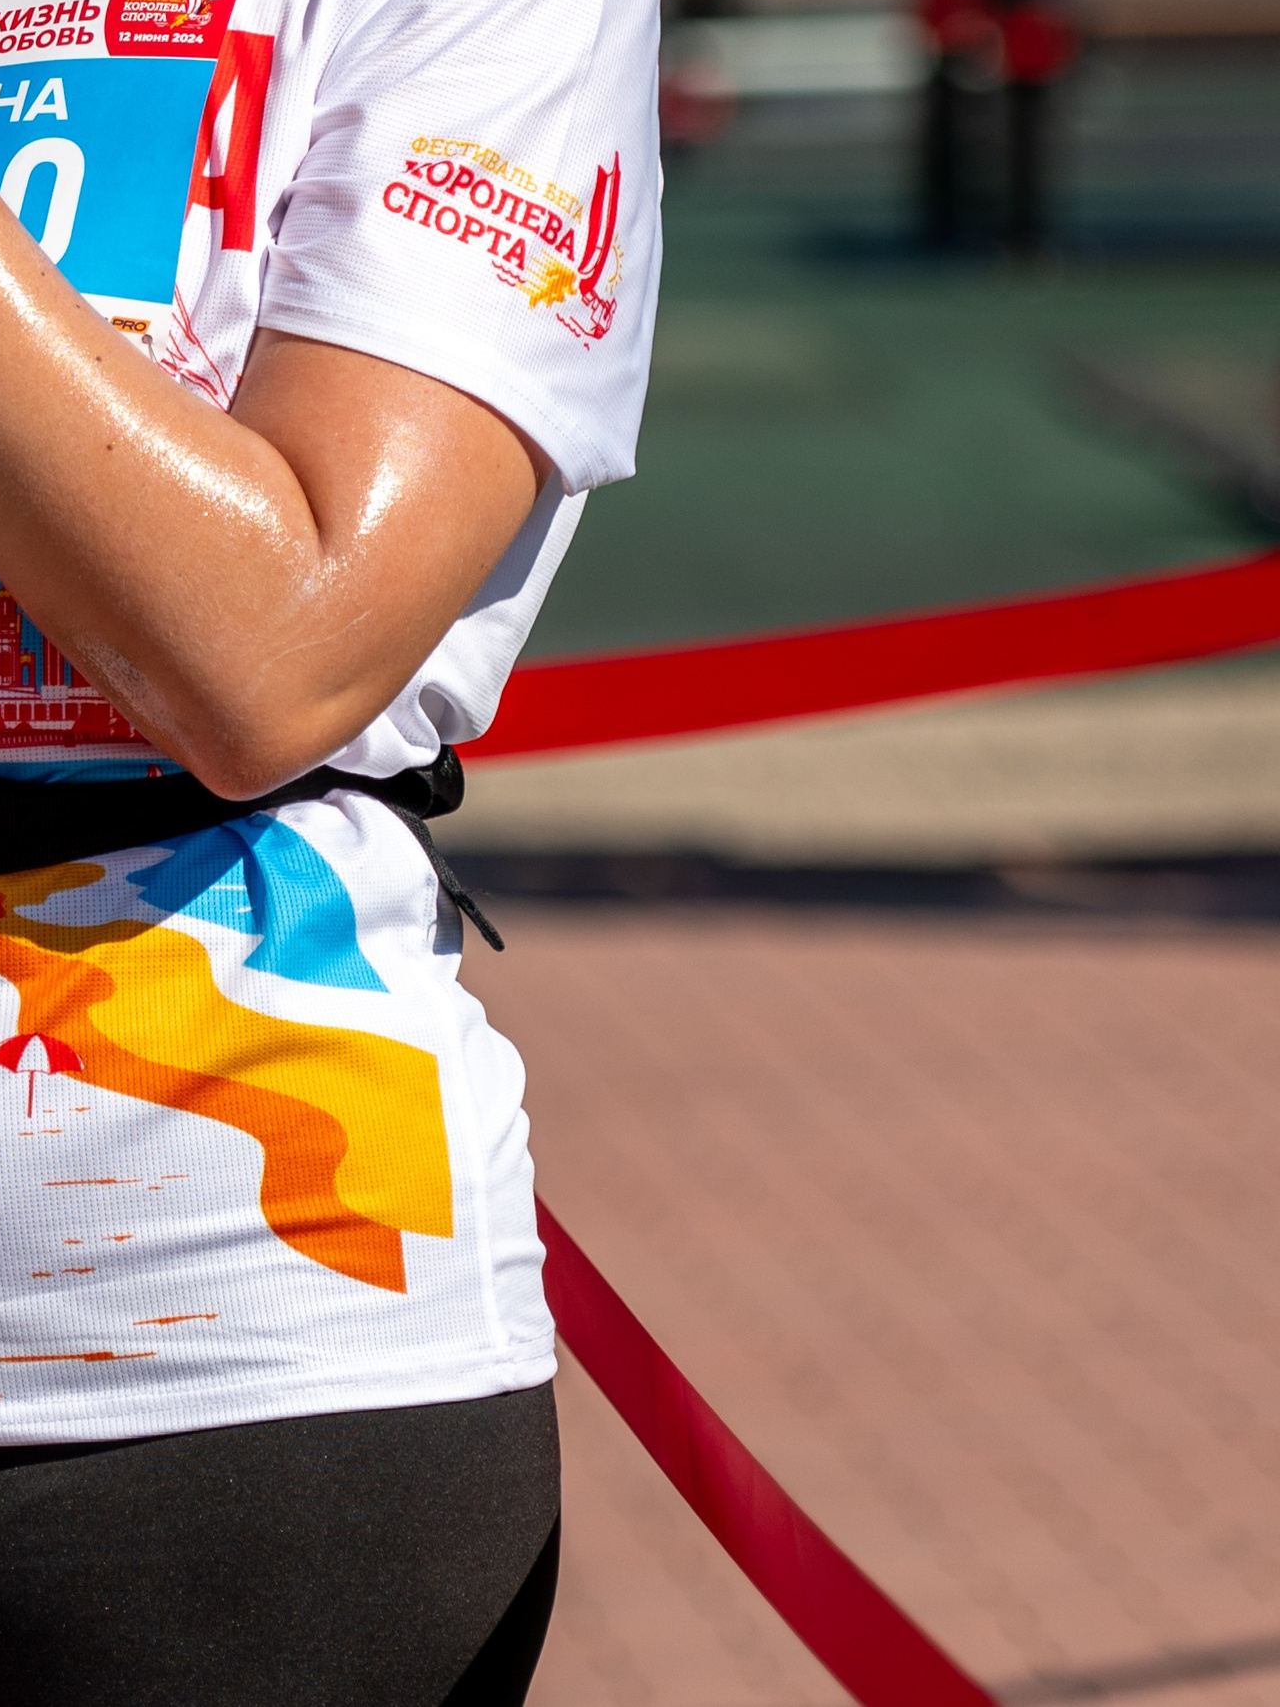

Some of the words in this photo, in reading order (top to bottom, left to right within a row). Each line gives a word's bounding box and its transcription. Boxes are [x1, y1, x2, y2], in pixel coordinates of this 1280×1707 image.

[121, 12, 167, 22] СПОРТА
[123, 2, 186, 13] КОРОЛЕВА
[119, 32, 131, 42] 12
[133, 33, 170, 42] июня
[171, 33, 204, 44] 2024
[411, 135, 538, 193] ФЕСТИВАЛЬ
[543, 181, 584, 225] БЕГА
[382, 181, 527, 270] СПОРТА
[402, 159, 575, 261] КОРОЛЕВА
